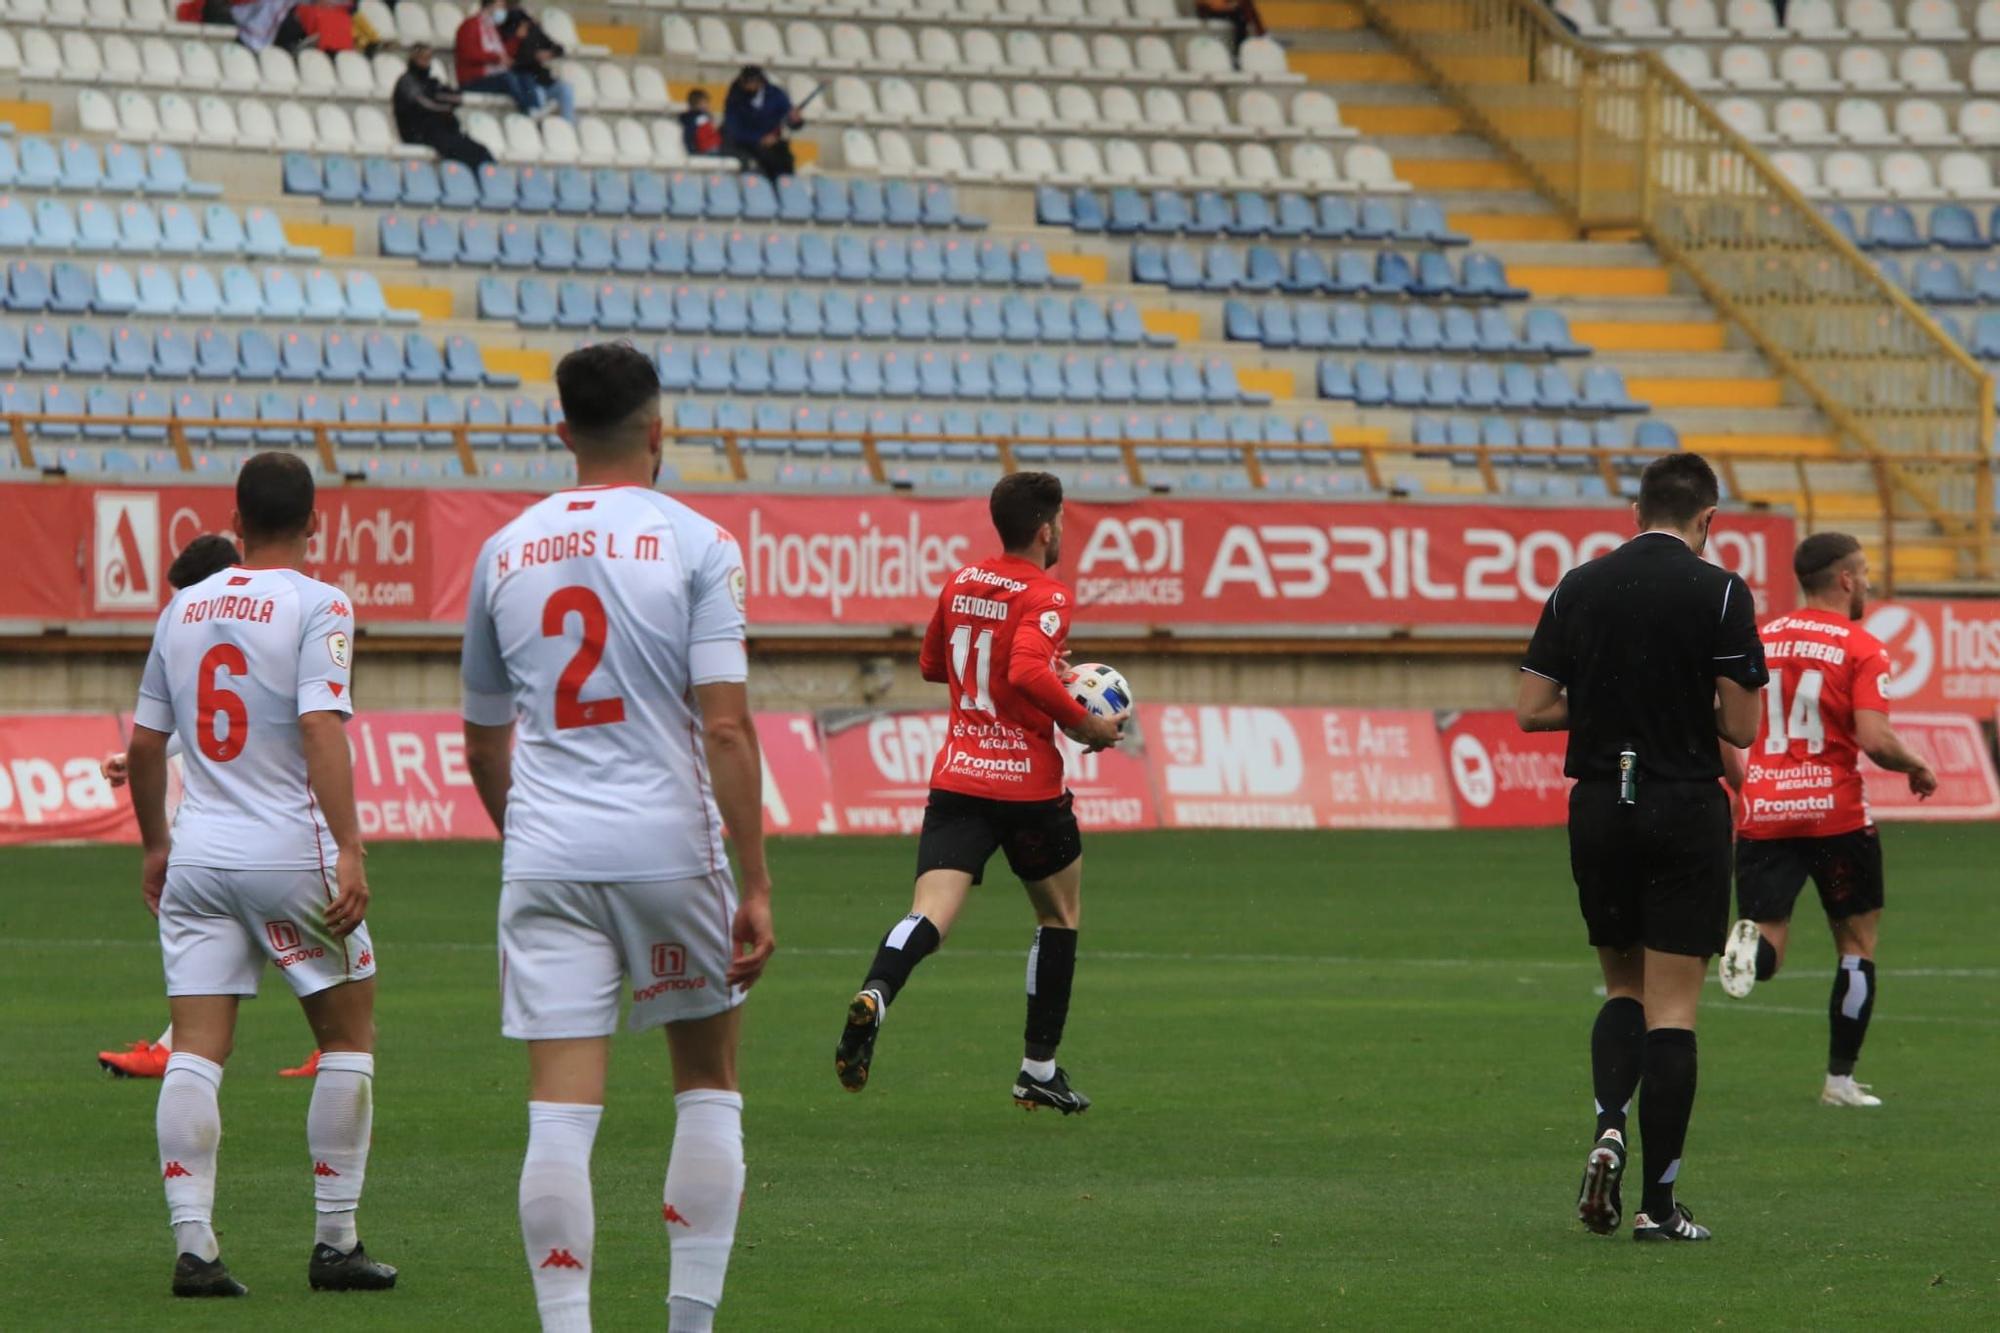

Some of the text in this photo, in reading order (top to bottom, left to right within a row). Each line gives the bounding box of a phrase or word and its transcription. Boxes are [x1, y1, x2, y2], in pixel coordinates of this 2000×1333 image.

[521, 530, 597, 568] RODAS
[750, 508, 970, 618] hospitales
[1202, 525, 1457, 598] ABRIL
[183, 596, 274, 624] ROVIROLA
[541, 586, 627, 730] 2
[1793, 640, 1845, 665] PERERO
[949, 624, 997, 718] 11
[196, 643, 248, 763] 6
[1761, 668, 1825, 755] 14
[979, 738, 1028, 750] MEGALAB
[953, 751, 1031, 773] Pronatal
[985, 770, 1023, 782] Services
[1764, 761, 1831, 780] eurofins
[1775, 777, 1833, 790] MEGALAB
[1754, 794, 1834, 813] Pronatal
